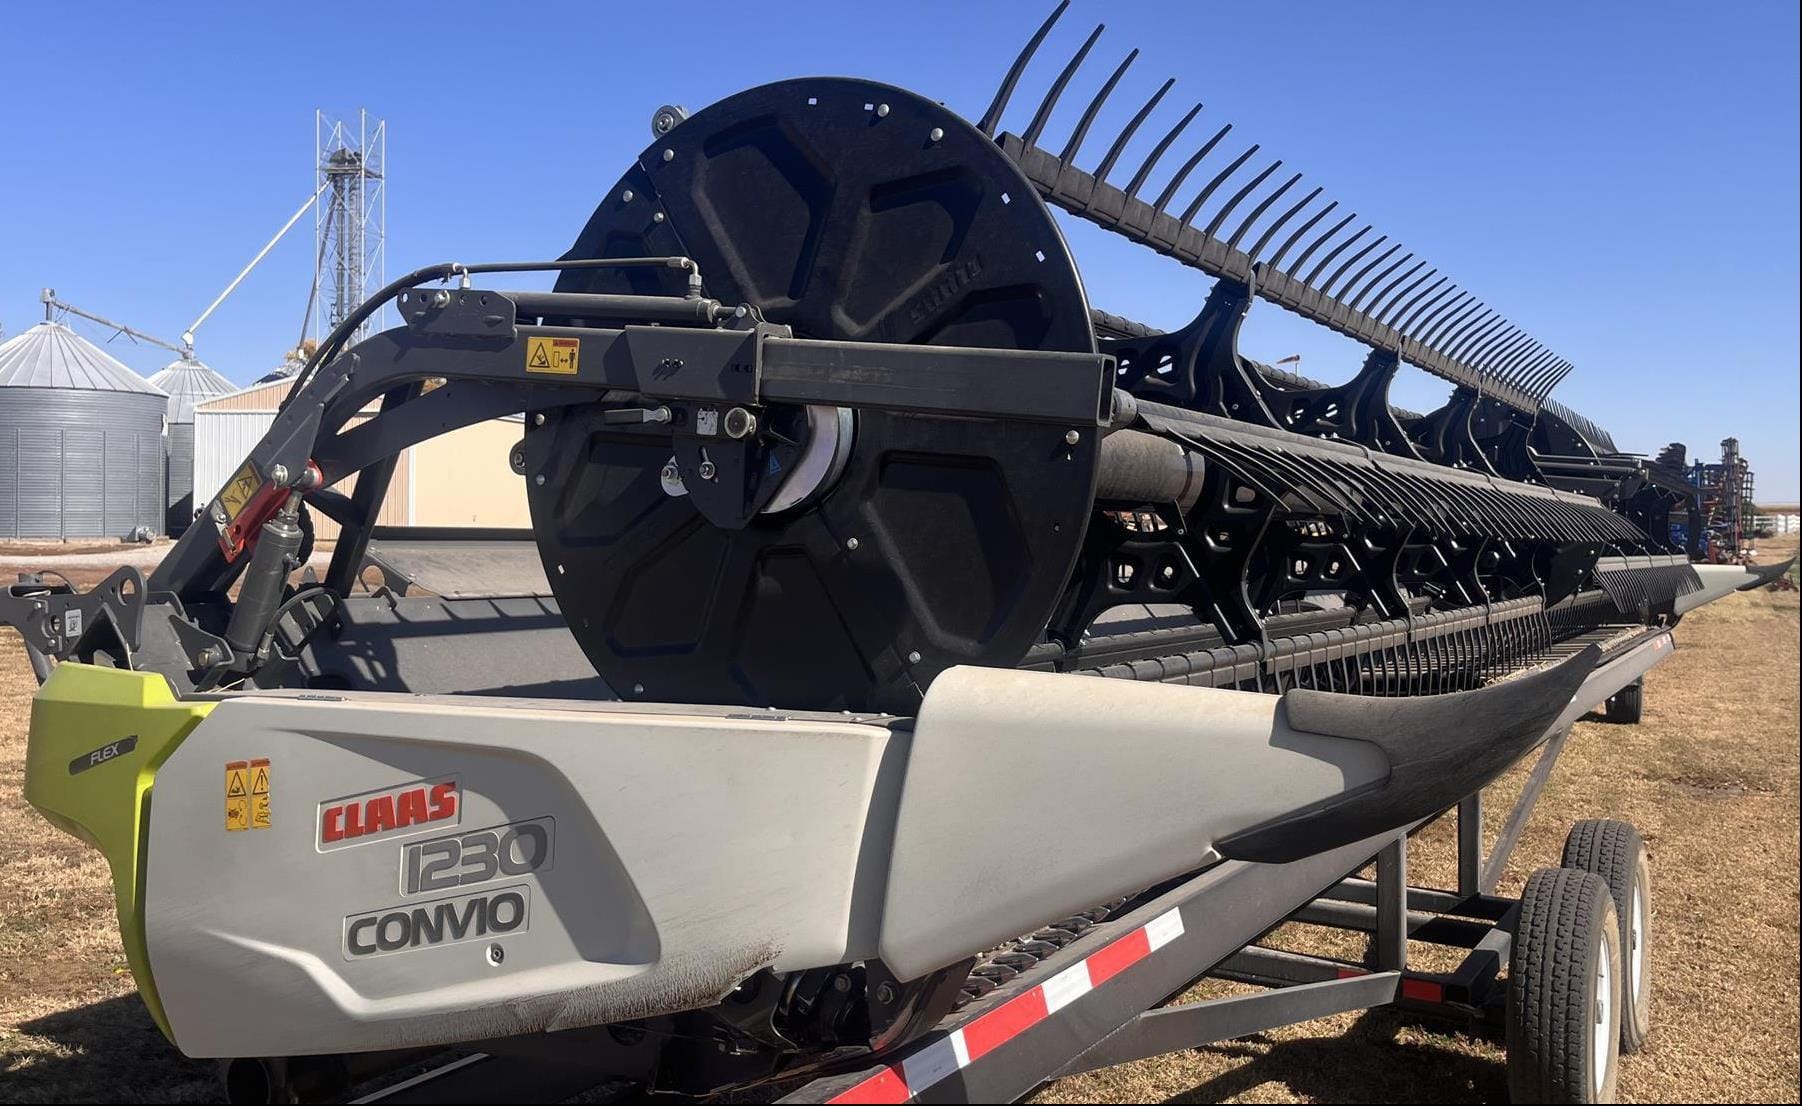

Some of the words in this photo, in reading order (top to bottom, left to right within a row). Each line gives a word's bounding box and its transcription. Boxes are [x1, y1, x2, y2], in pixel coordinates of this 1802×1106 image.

[90, 742, 119, 765] FLEX
[321, 780, 457, 844] CLAAS
[407, 823, 548, 894] 1230
[347, 892, 525, 956] CONVIO
